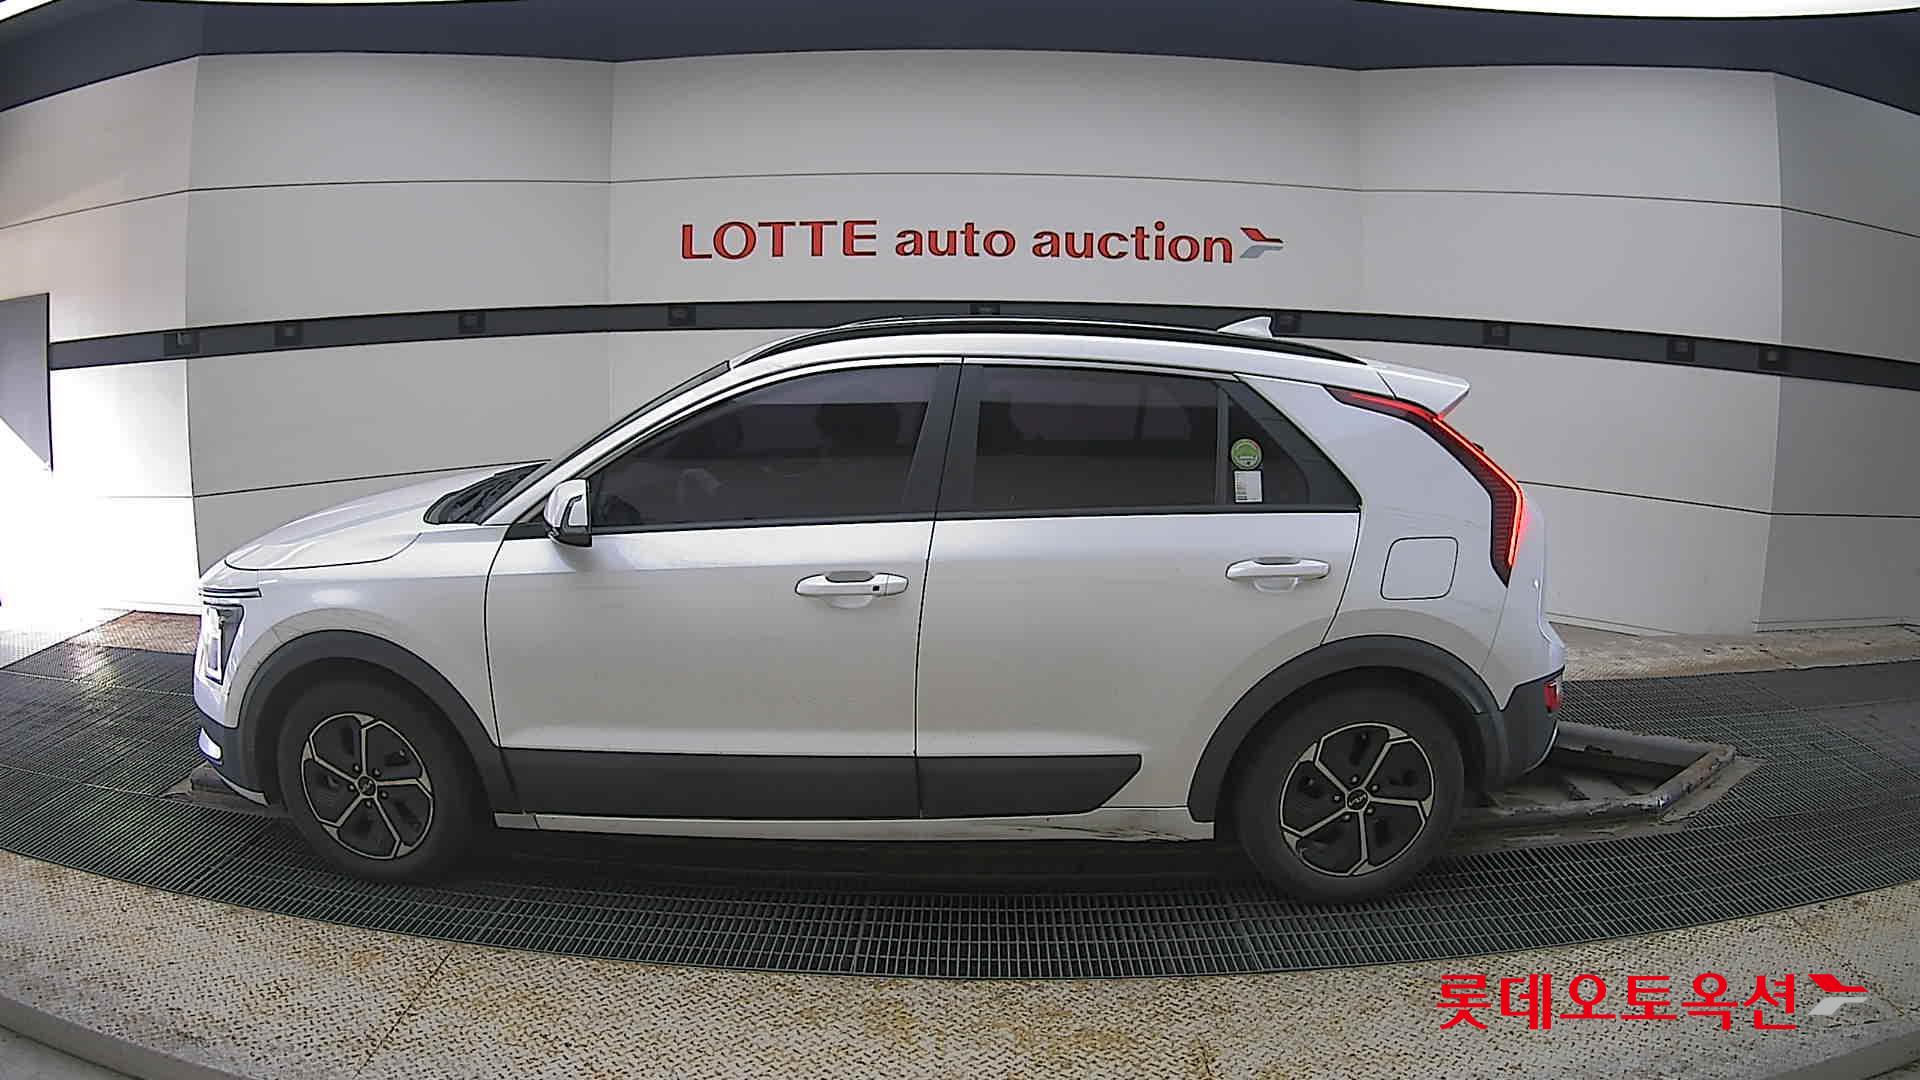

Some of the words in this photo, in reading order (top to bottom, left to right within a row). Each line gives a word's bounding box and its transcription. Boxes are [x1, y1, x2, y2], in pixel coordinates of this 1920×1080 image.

[681, 219, 877, 260] LOTTE
[894, 221, 1017, 257] auto
[1031, 220, 1233, 264] auction
